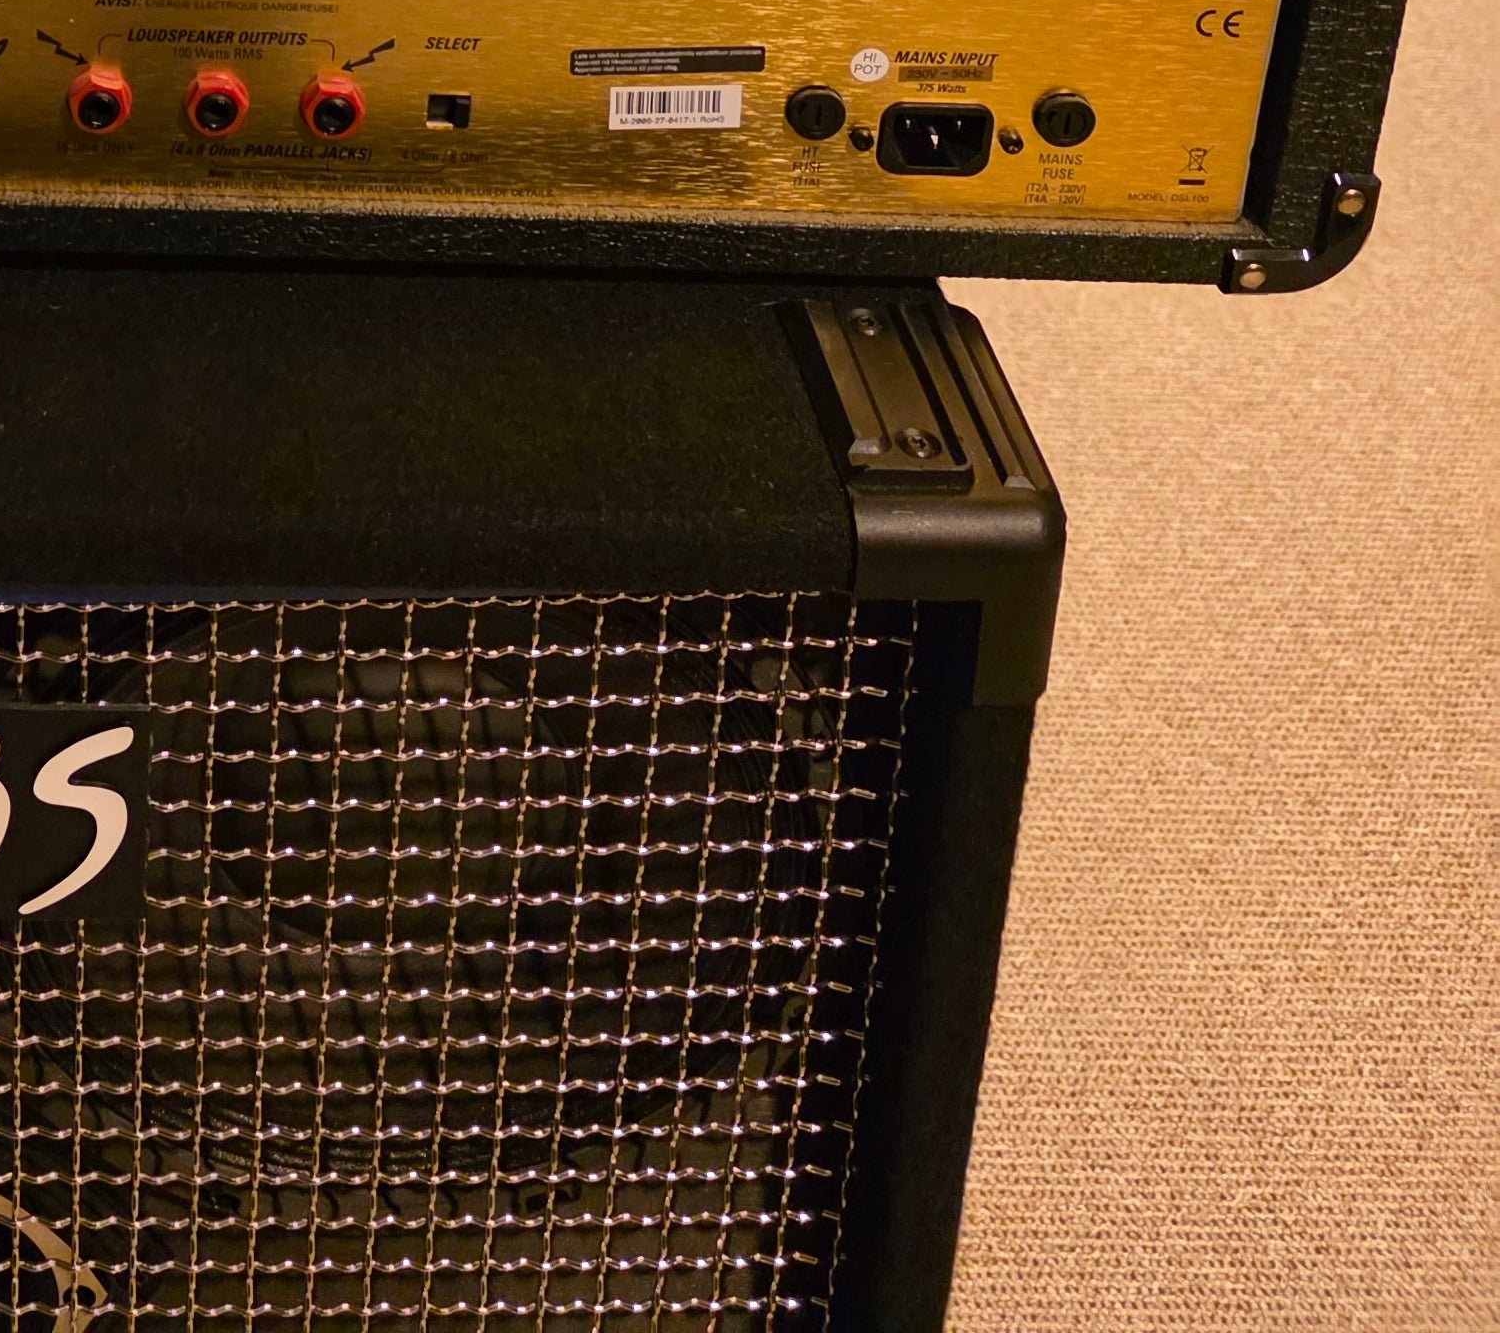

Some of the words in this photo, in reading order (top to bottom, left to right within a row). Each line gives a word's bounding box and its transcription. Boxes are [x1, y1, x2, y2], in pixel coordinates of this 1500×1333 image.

[127, 28, 234, 45] LOUDSPEAKER
[238, 30, 309, 46] OUTPUTS
[424, 36, 481, 52] SELECT
[172, 47, 192, 59] 100
[196, 47, 231, 60] Watts
[233, 48, 264, 60] RMS
[863, 52, 877, 63] HI
[894, 51, 948, 65] MAINS
[949, 52, 999, 67] INPUT
[854, 64, 882, 75] POT
[906, 69, 939, 79] 230V
[951, 69, 984, 79] 50Hz
[916, 83, 935, 93] 375
[937, 83, 967, 94] Watts
[209, 144, 241, 156] Ohm
[243, 144, 314, 158] PARALLEL
[318, 145, 373, 162] JACKS)
[803, 146, 818, 158] HT
[1038, 153, 1083, 165] MAINS
[1042, 168, 1075, 180] FUSE
[1026, 183, 1049, 193] (T2A
[1059, 183, 1087, 194] 230V)
[1024, 194, 1047, 204] (T4A
[1058, 194, 1085, 205] 120V)
[1127, 192, 1168, 202] MODEL:
[1170, 193, 1209, 203] DSL100
